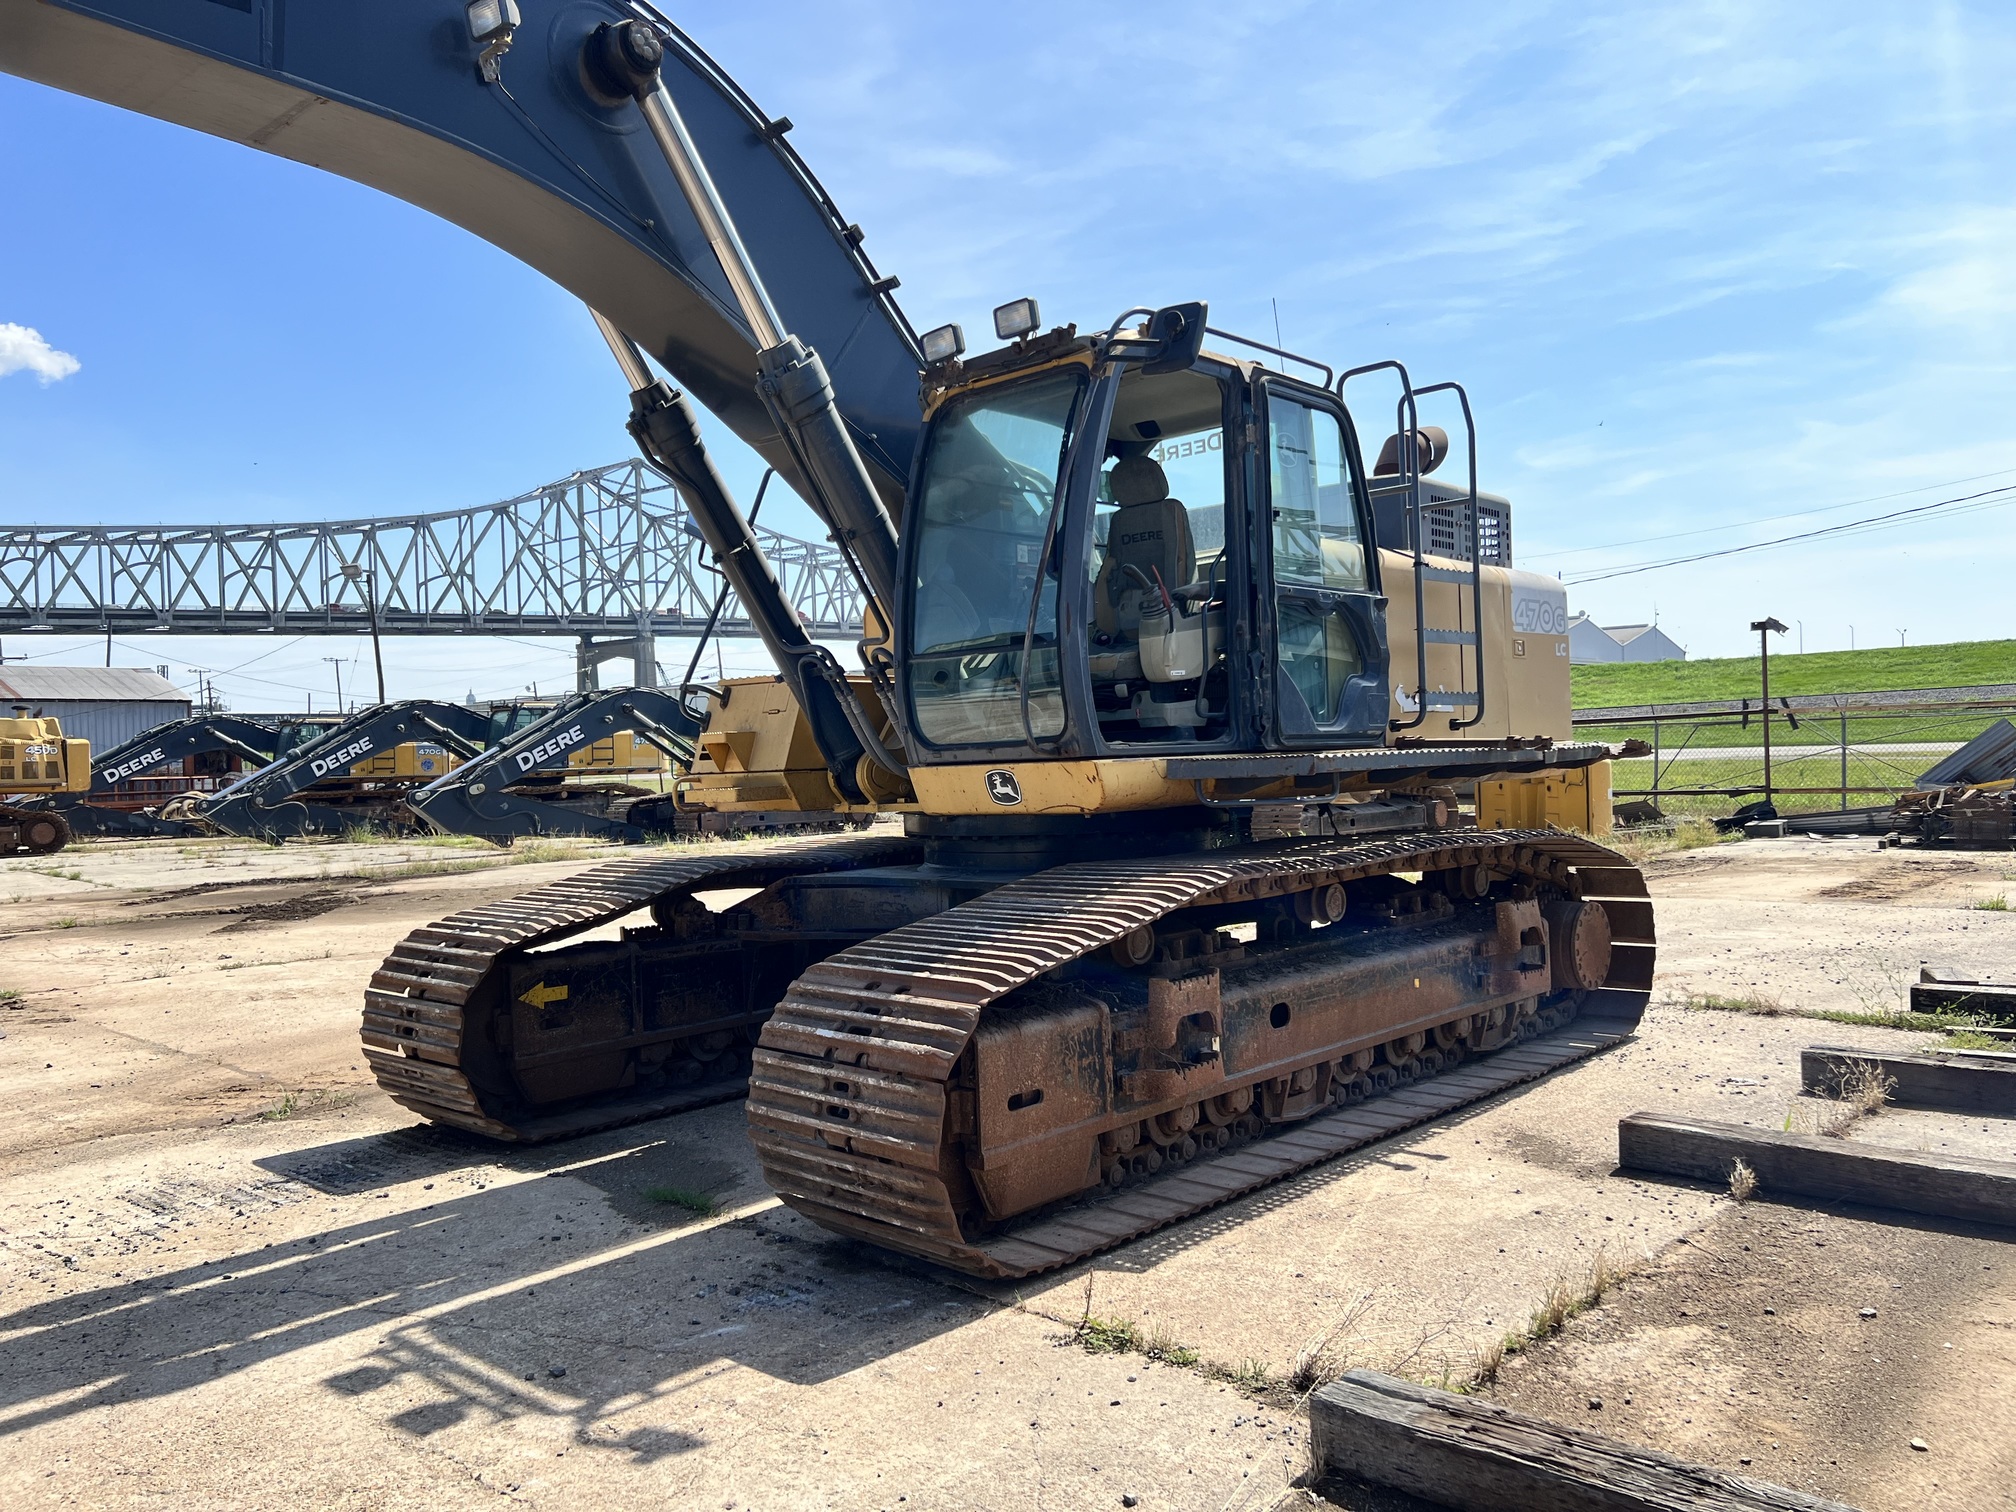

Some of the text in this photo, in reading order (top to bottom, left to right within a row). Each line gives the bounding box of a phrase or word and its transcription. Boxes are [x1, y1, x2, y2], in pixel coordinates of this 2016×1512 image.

[1121, 530, 1164, 545] DEERE
[1515, 598, 1566, 634] 470G
[1555, 642, 1567, 656] LC
[25, 745, 59, 755] 450D
[102, 747, 166, 784] DEERE
[310, 736, 374, 777] DEERE
[515, 724, 585, 772] DEERE
